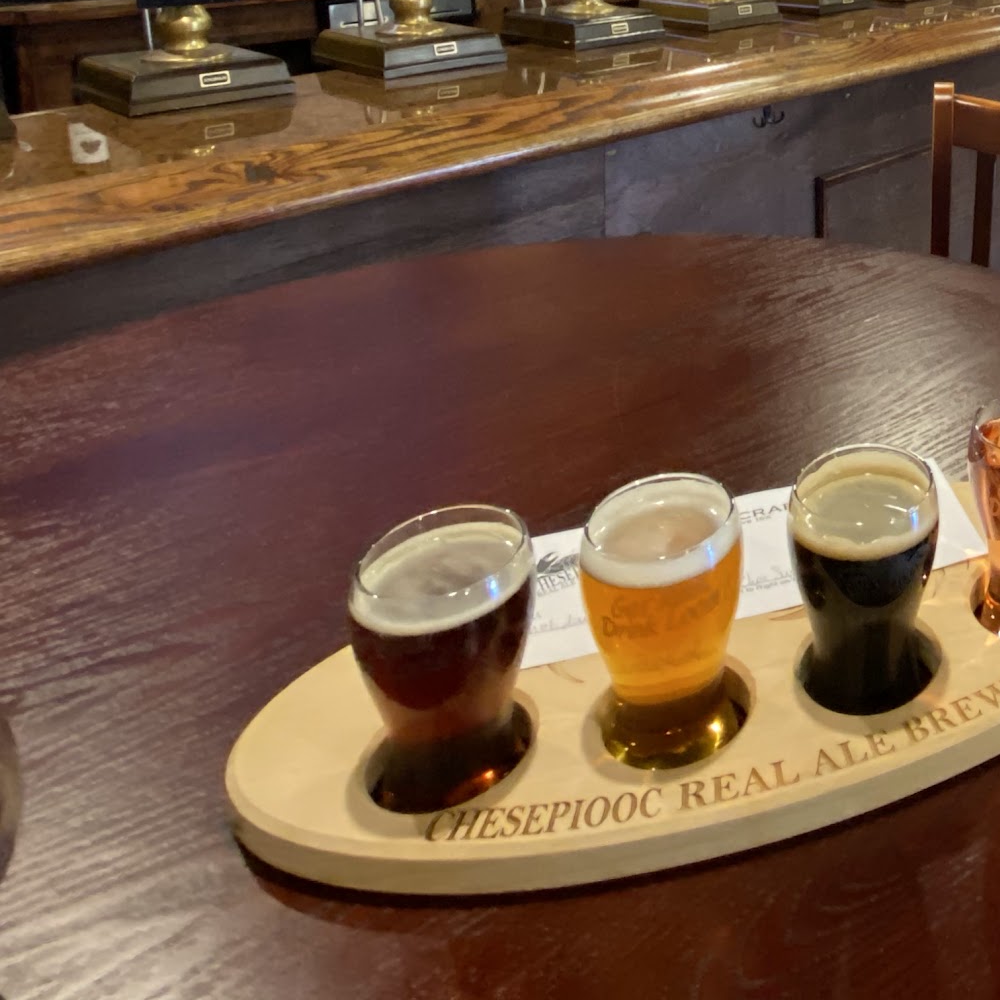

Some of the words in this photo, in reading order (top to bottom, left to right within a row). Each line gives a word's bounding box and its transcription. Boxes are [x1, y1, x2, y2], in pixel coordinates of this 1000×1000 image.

[425, 787, 663, 842] CHESEPIOOC
[678, 759, 800, 811] REAL
[815, 729, 895, 776] ALE
